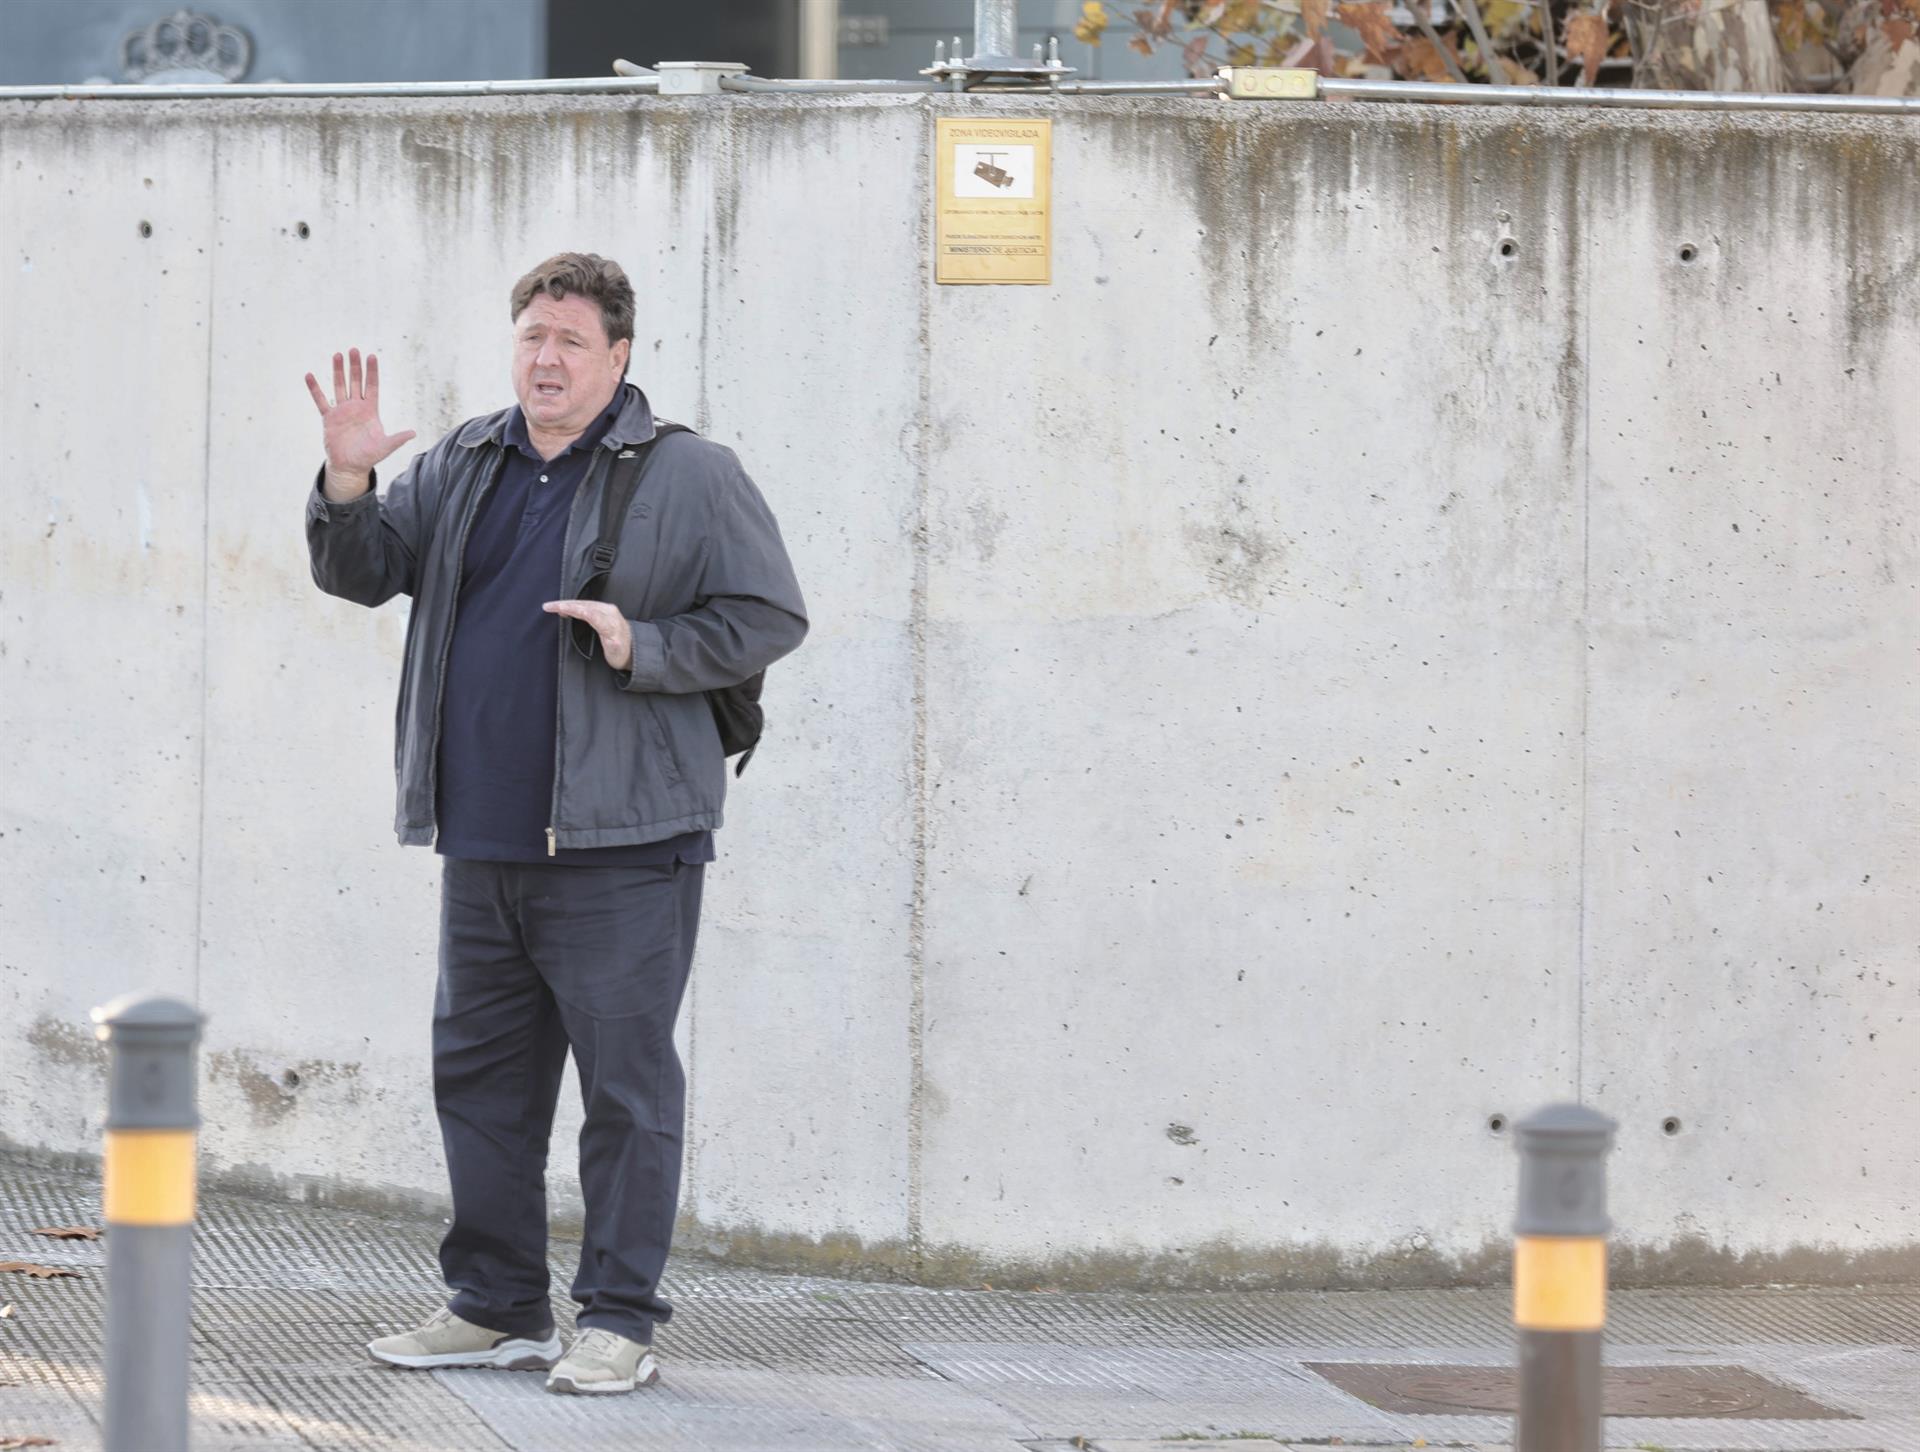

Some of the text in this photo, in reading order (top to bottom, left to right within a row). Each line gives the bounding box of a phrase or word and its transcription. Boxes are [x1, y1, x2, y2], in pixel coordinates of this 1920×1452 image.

[949, 128, 1040, 138] ZONA VIDEOVIGILADA
[949, 246, 991, 254] MINISTERIO
